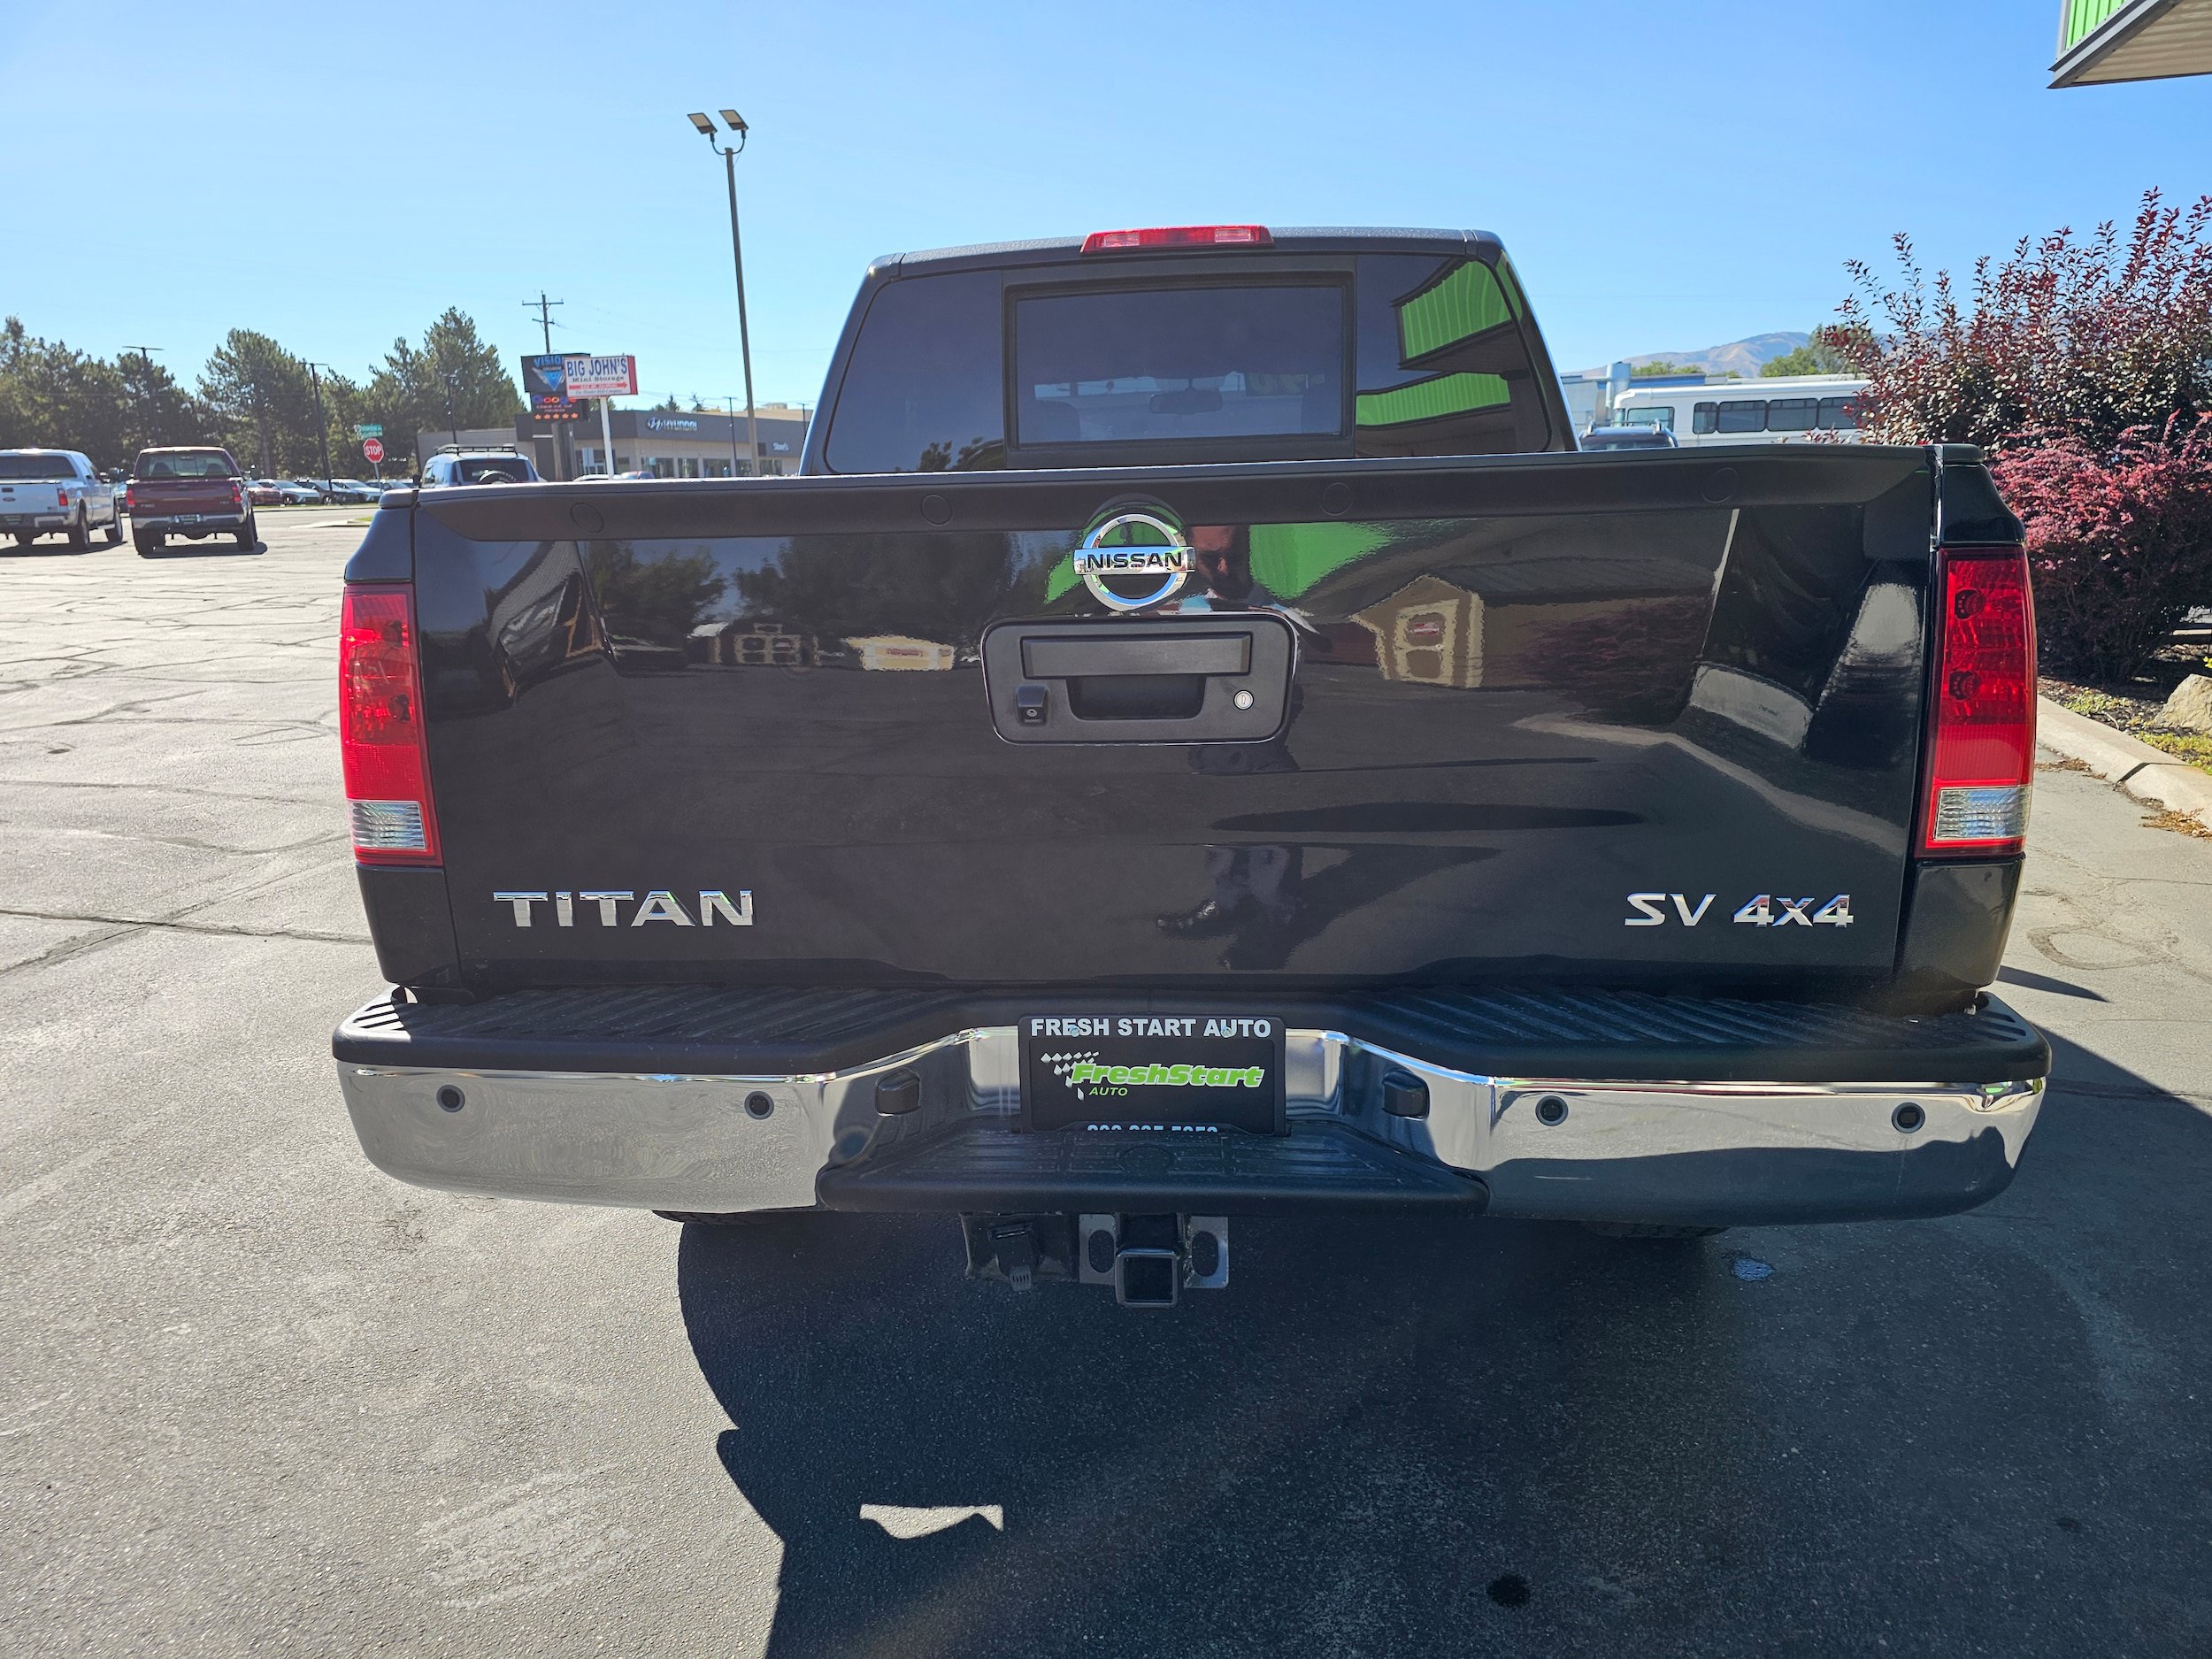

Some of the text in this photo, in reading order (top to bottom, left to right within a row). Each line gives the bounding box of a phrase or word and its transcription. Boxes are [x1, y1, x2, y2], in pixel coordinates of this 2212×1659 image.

[534, 355, 564, 367] VISIO
[566, 357, 627, 377] BIG JOHN'S
[365, 445, 381, 456] STOP
[1087, 552, 1182, 569] NISSAN
[493, 890, 754, 927] TITAN
[1624, 892, 1717, 926] SV
[1031, 1018, 1271, 1038] FRESH START AUTO
[1071, 1063, 1265, 1088] FreshStart
[1088, 1086, 1129, 1097] AUTO
